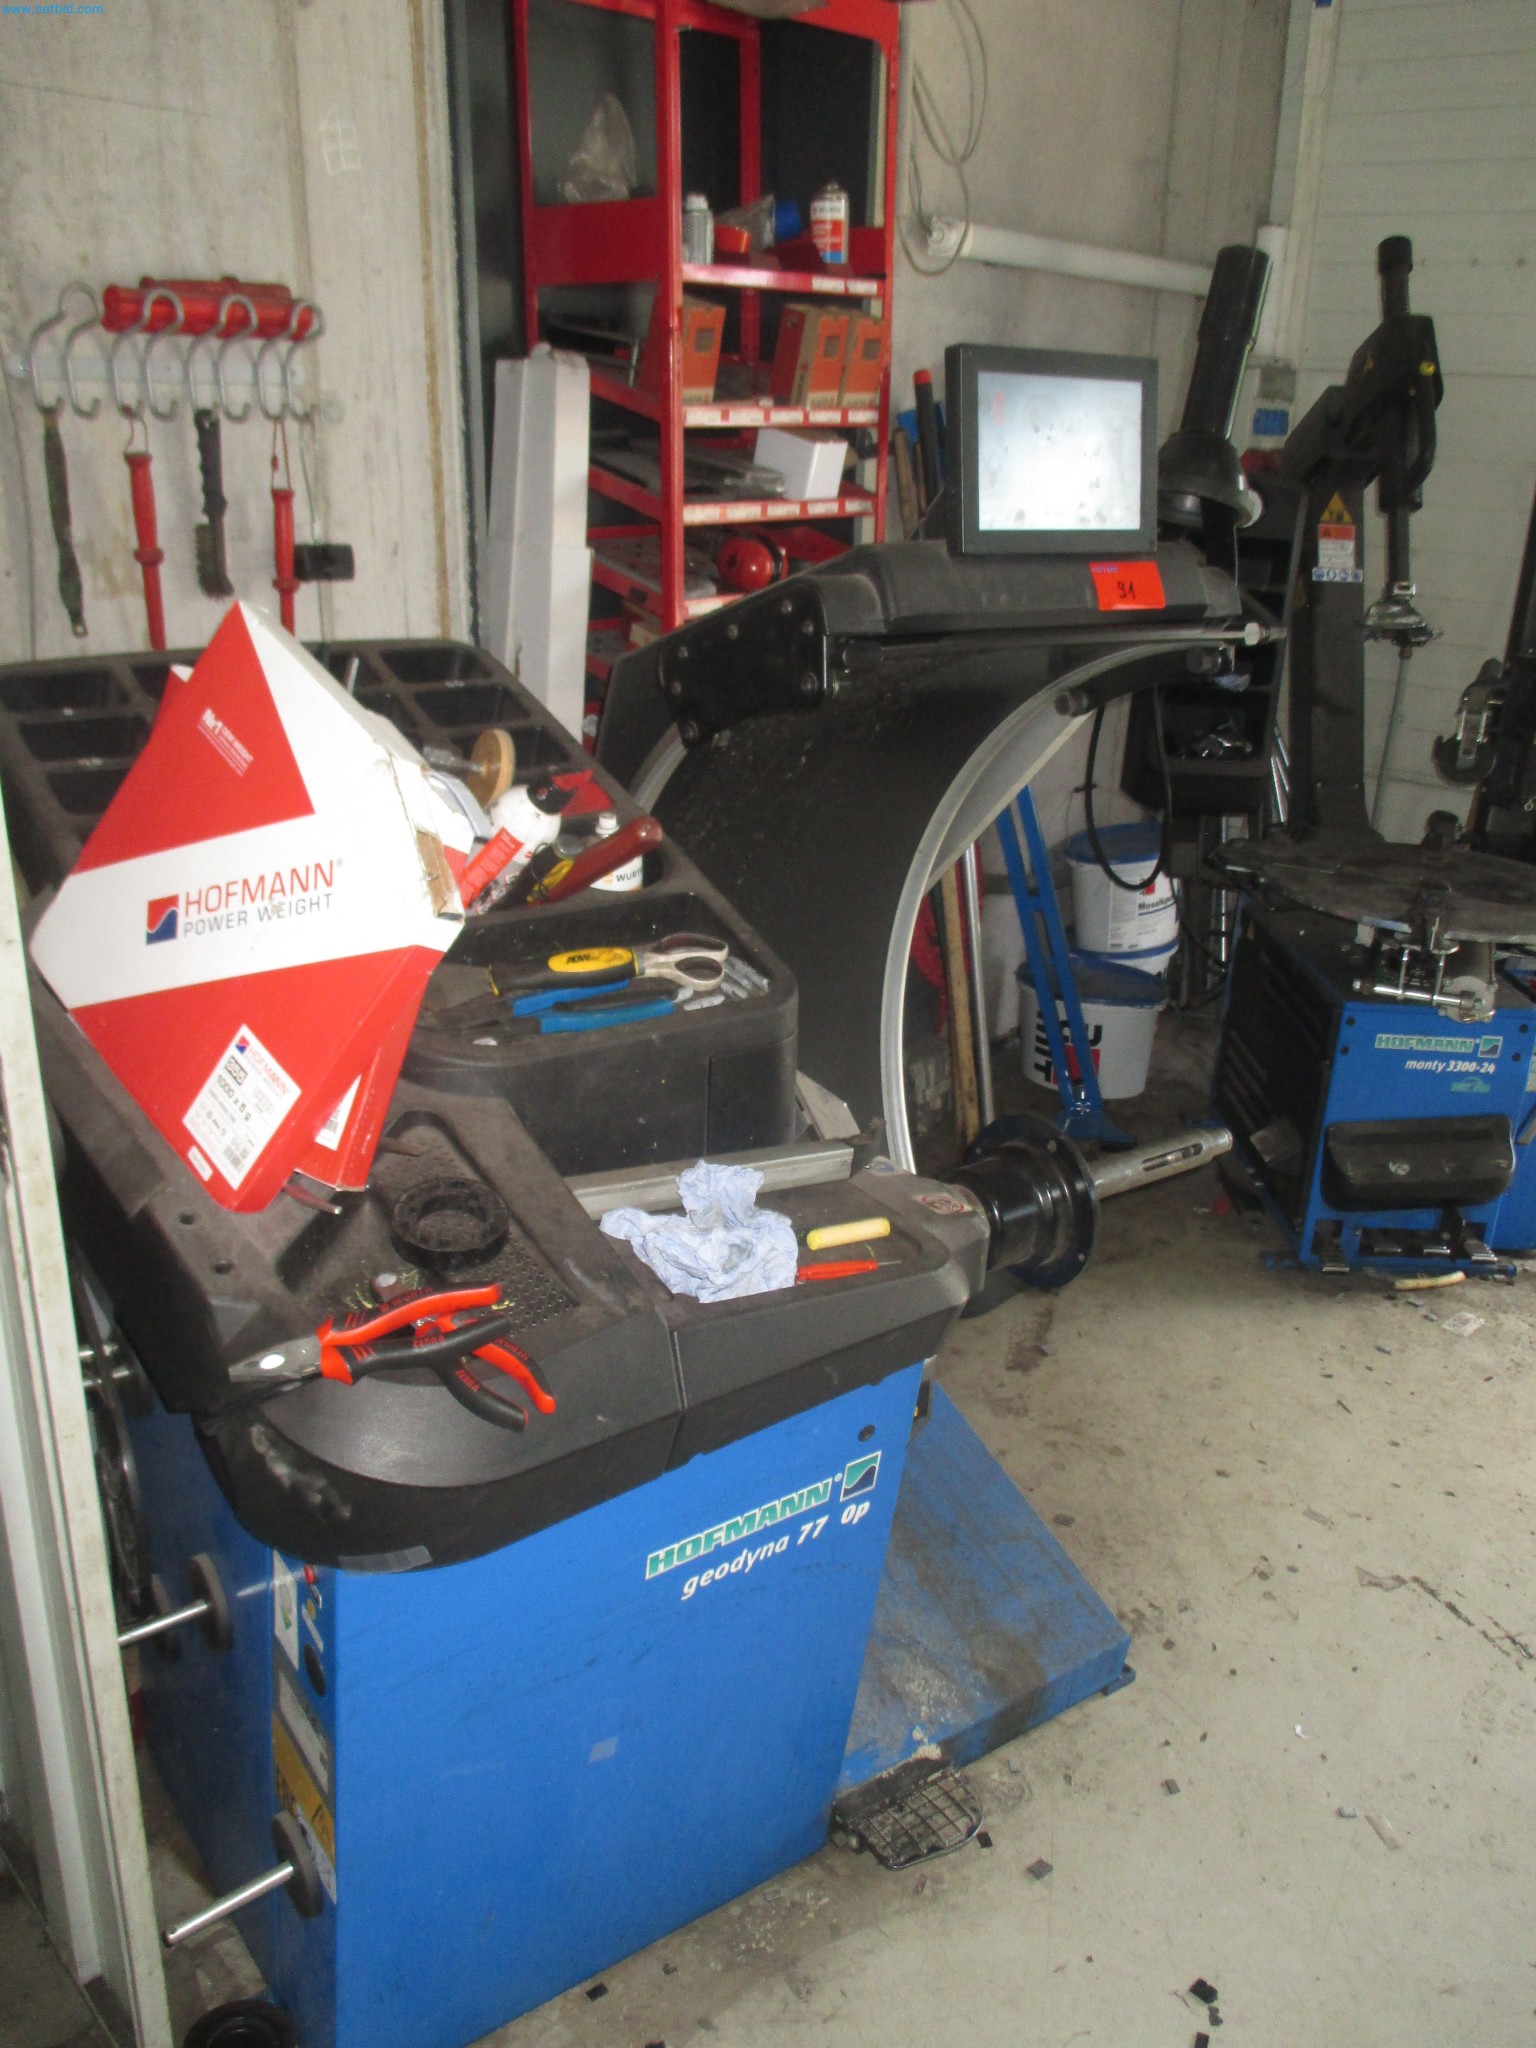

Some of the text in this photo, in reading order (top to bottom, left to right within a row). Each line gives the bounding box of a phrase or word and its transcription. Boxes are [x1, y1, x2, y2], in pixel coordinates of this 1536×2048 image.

[185, 860, 334, 917] HOFMANN
[184, 893, 333, 938] POWER WEIGHT
[1375, 1033, 1475, 1053] HOFMANN
[1405, 1059, 1496, 1074] monty 3300-24
[646, 1478, 833, 1580] HOFMANN
[681, 1535, 790, 1601] geodyna
[797, 1515, 830, 1546] 77
